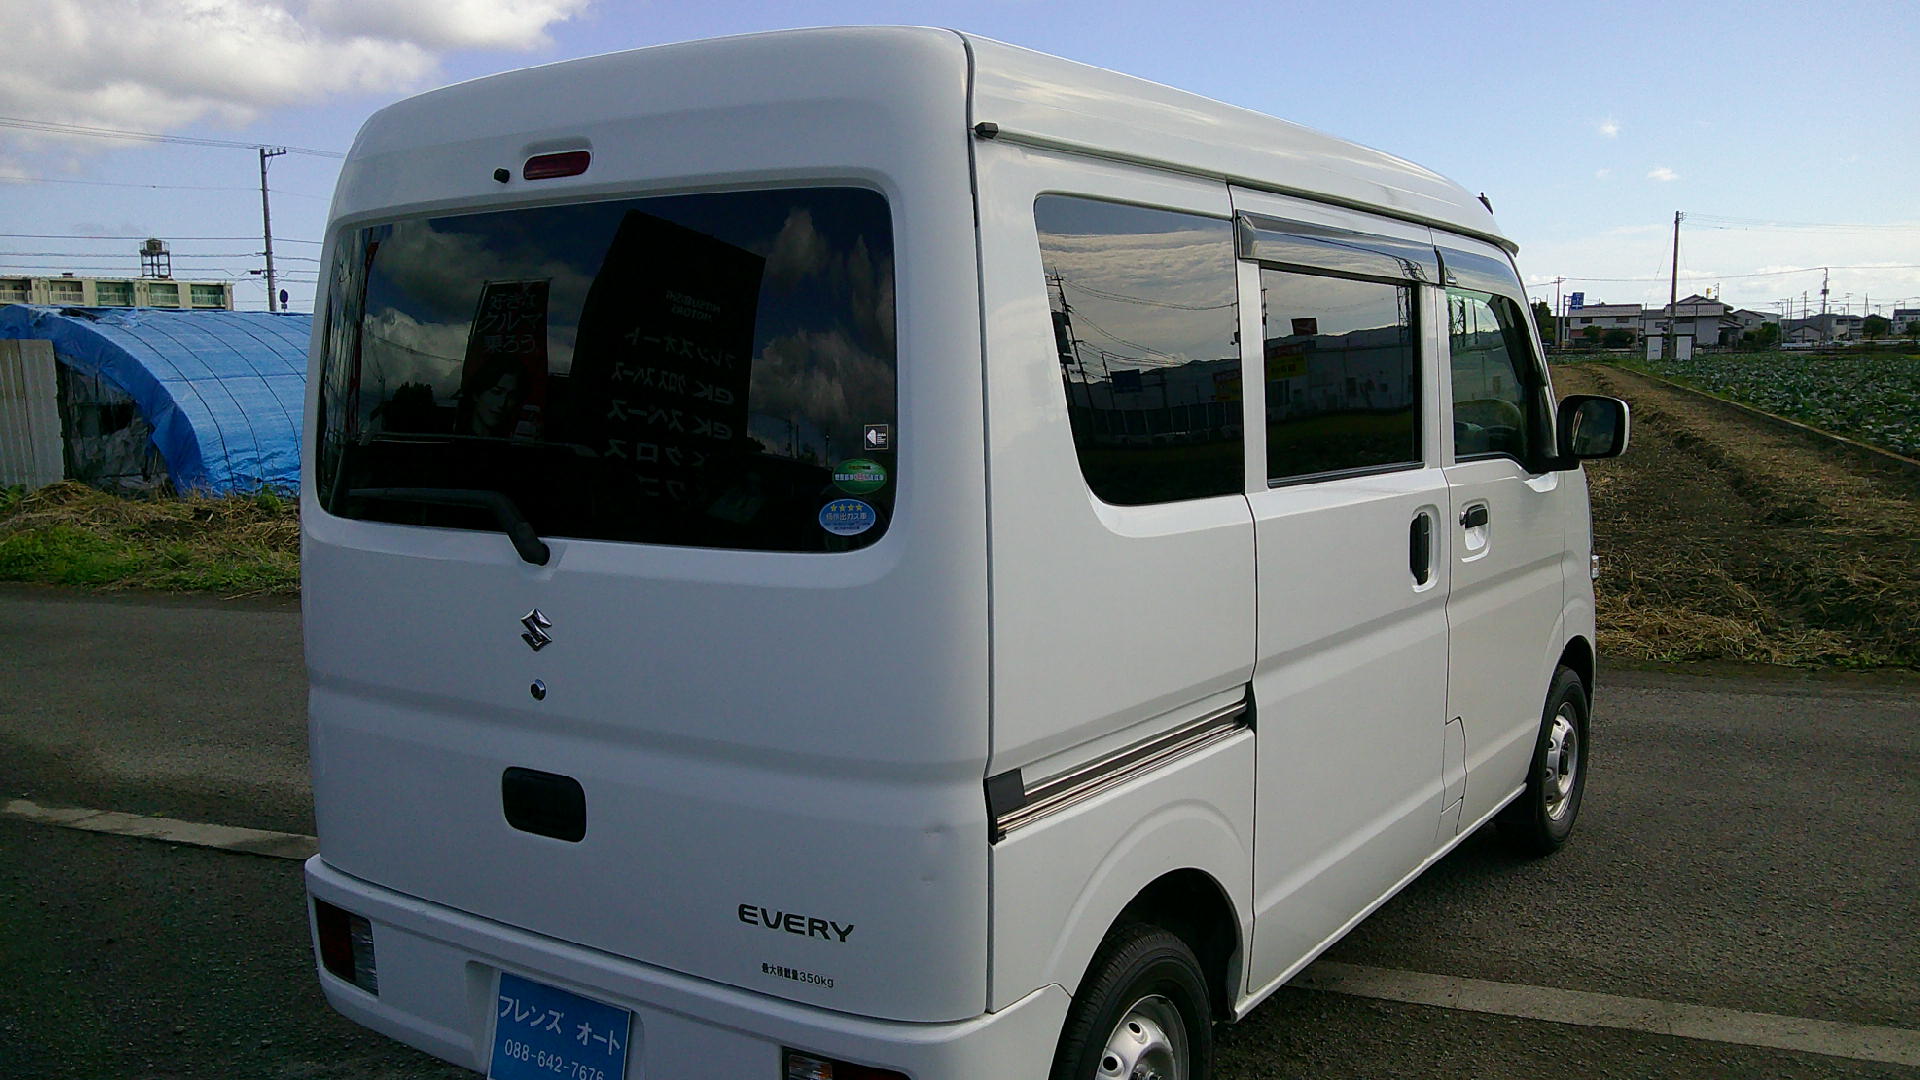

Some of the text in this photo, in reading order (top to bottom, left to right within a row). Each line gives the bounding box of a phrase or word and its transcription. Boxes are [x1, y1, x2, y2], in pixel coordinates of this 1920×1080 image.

[738, 903, 854, 943] EVERY
[500, 995, 621, 1056] フレンズ オート
[504, 1039, 604, 1080] 088-642-7676
